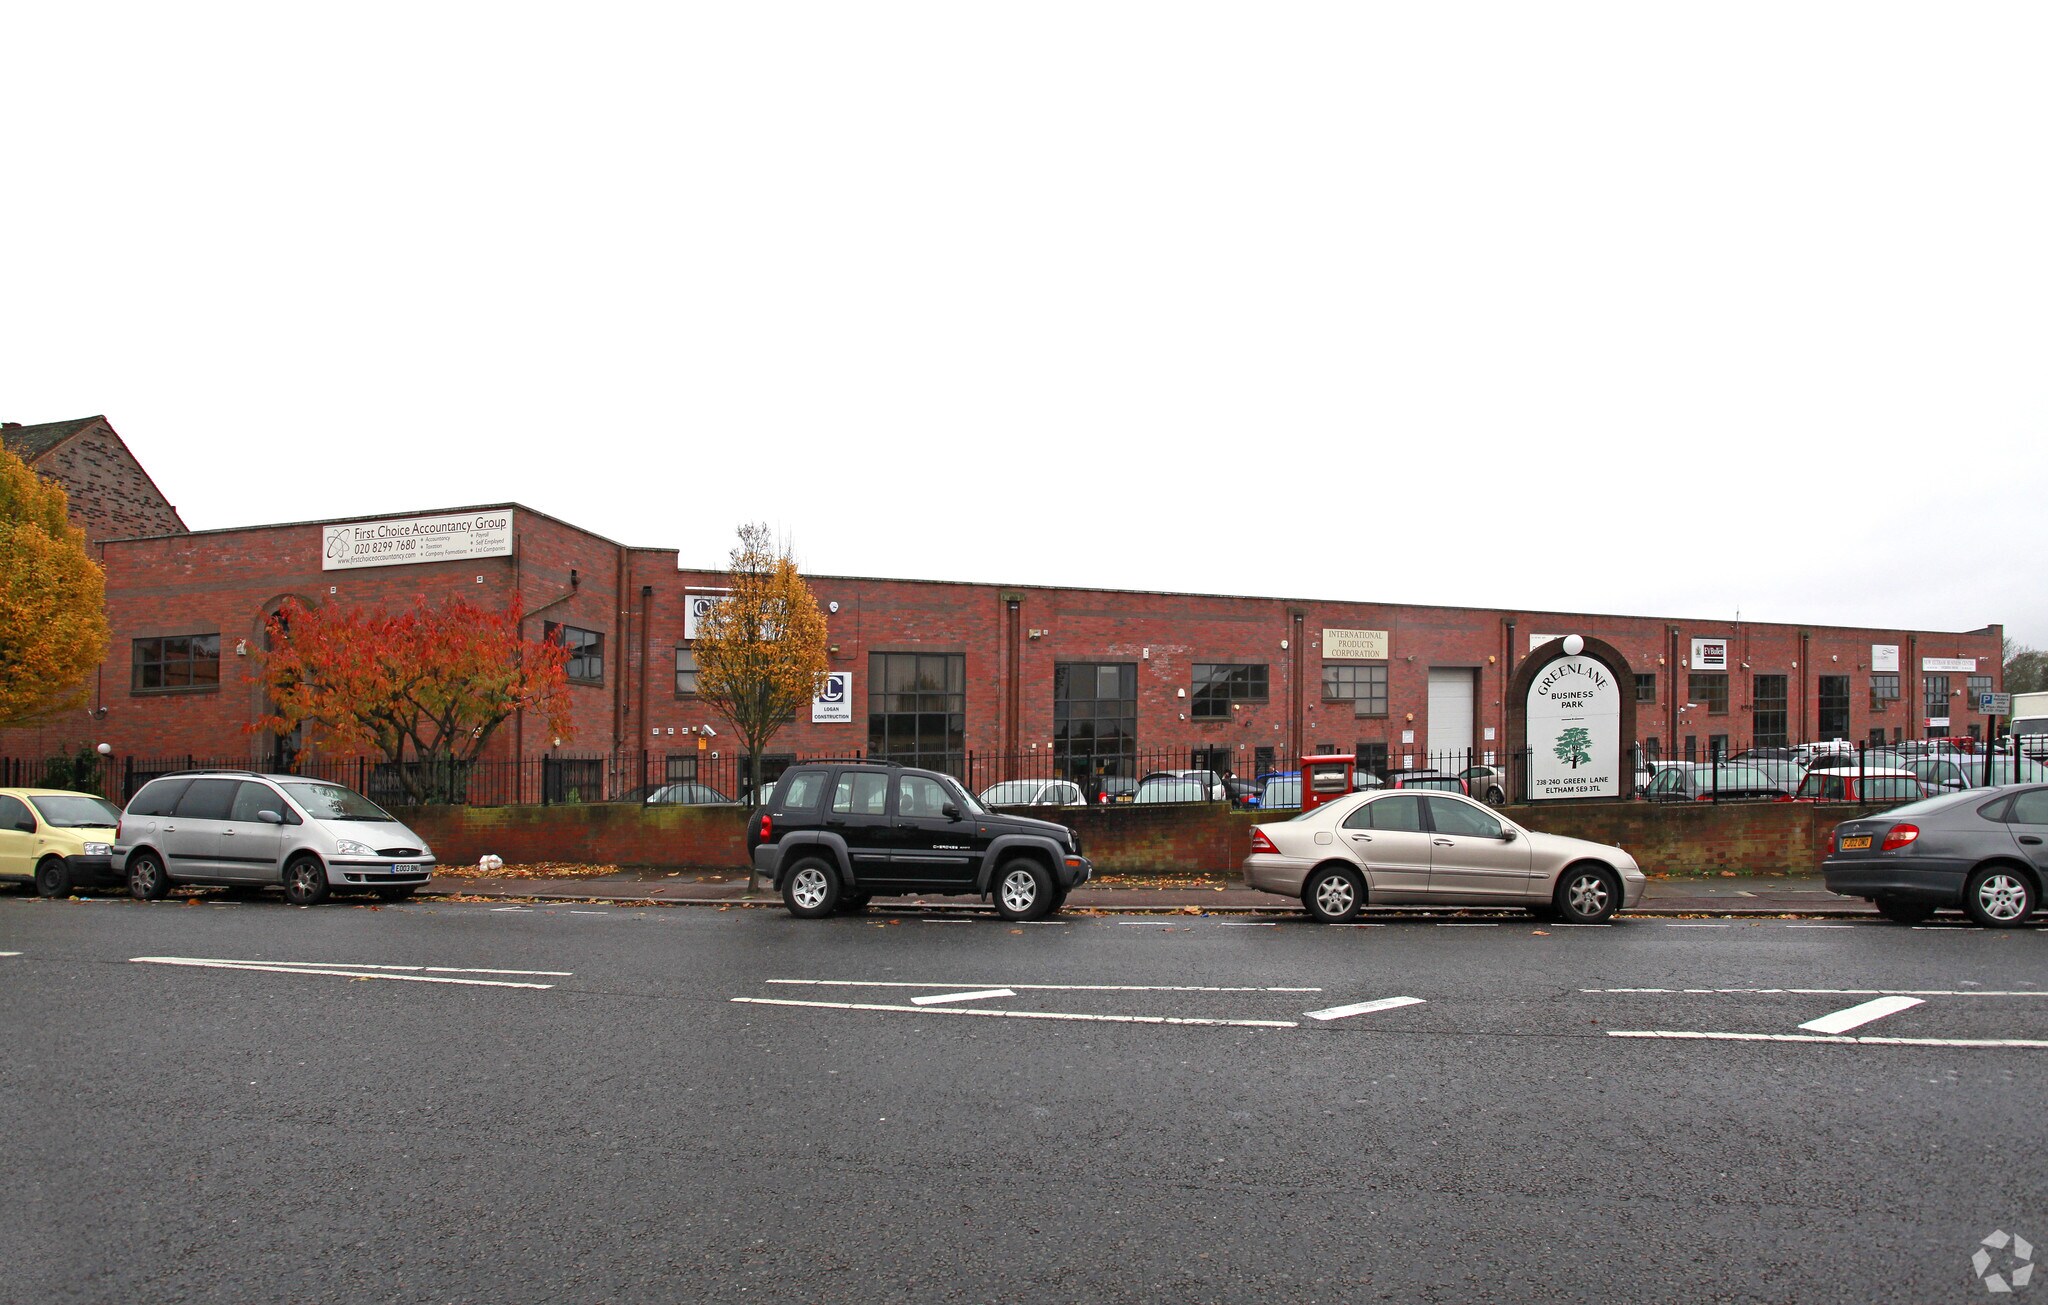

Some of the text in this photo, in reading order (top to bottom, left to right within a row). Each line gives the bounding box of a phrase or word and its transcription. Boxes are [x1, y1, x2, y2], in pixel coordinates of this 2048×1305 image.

[355, 517, 507, 540] First Choice Accountancy Group
[354, 539, 416, 554] 020 8299 7680
[1328, 630, 1382, 639] INTERNATIONAL
[1338, 640, 1374, 648] PRODUCTS
[1332, 649, 1380, 657] CORPORATION
[1537, 663, 1608, 696] GREENLANE
[1551, 691, 1594, 700] BUSINESS
[1561, 701, 1584, 709] PARK
[1563, 777, 1587, 785] GREEN
[1589, 776, 1609, 784] LANE
[1545, 786, 1574, 794] ELTHAM
